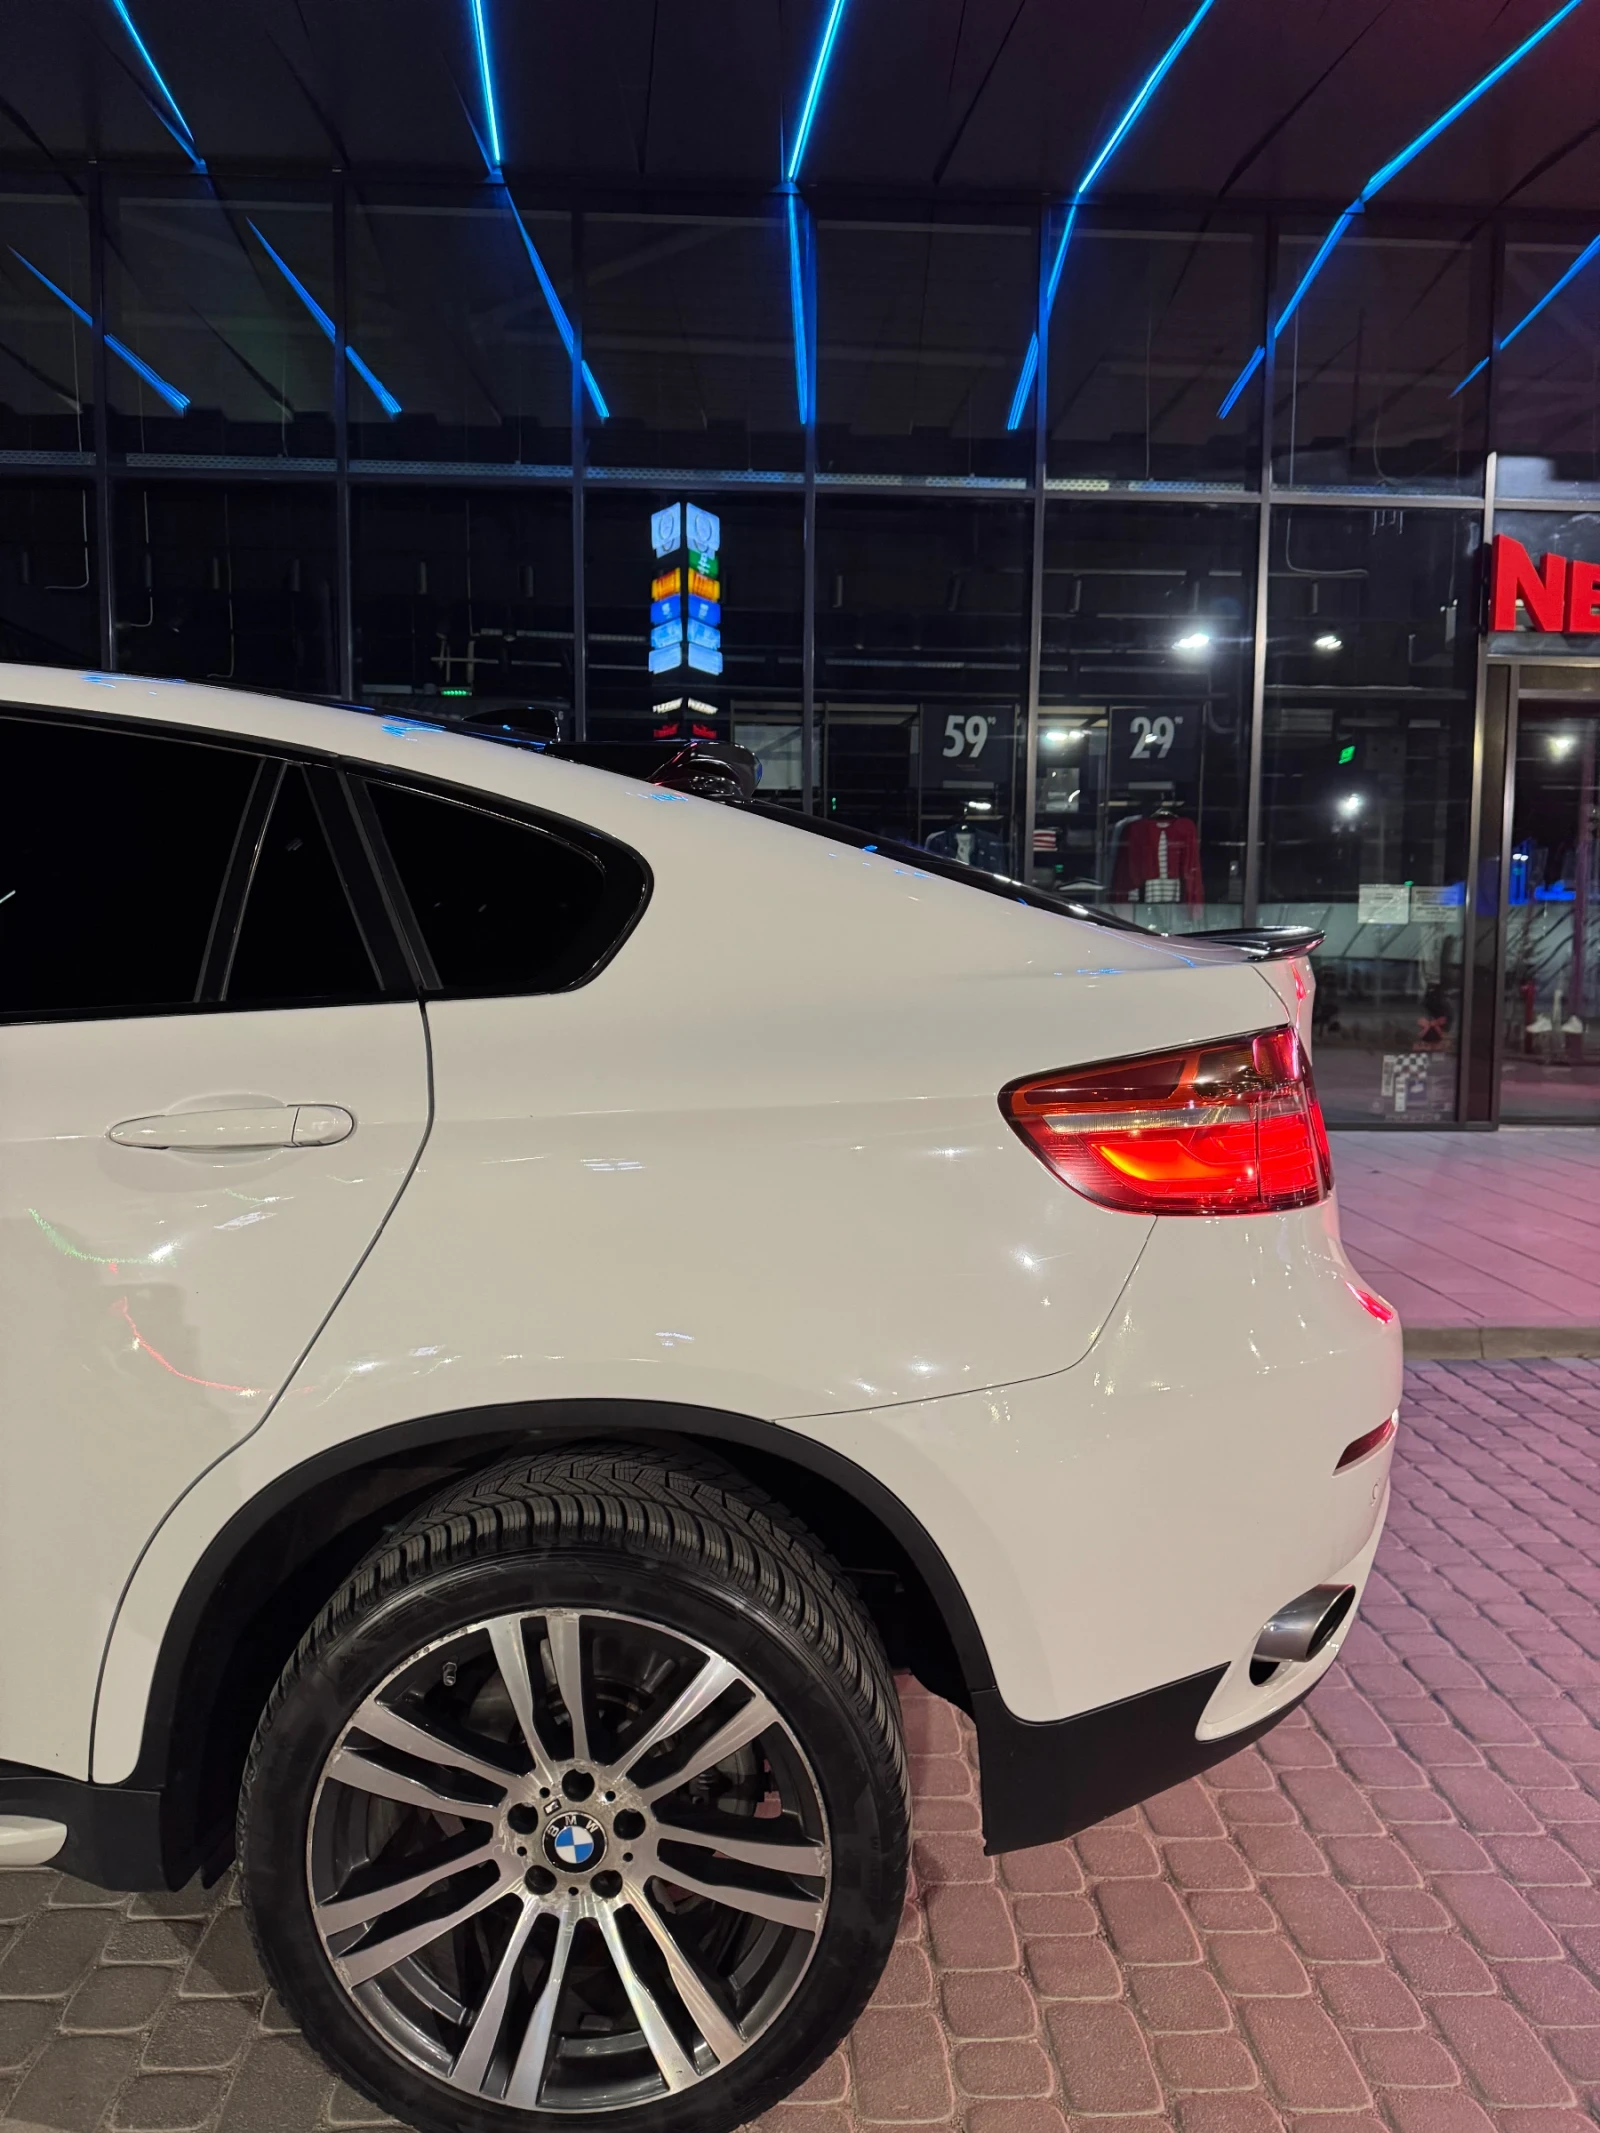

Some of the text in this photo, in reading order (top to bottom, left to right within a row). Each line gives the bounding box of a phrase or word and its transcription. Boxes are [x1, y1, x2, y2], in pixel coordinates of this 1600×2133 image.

[942, 715, 988, 758] 59
[1129, 716, 1175, 759] 29
[547, 1815, 599, 1838] BMW
